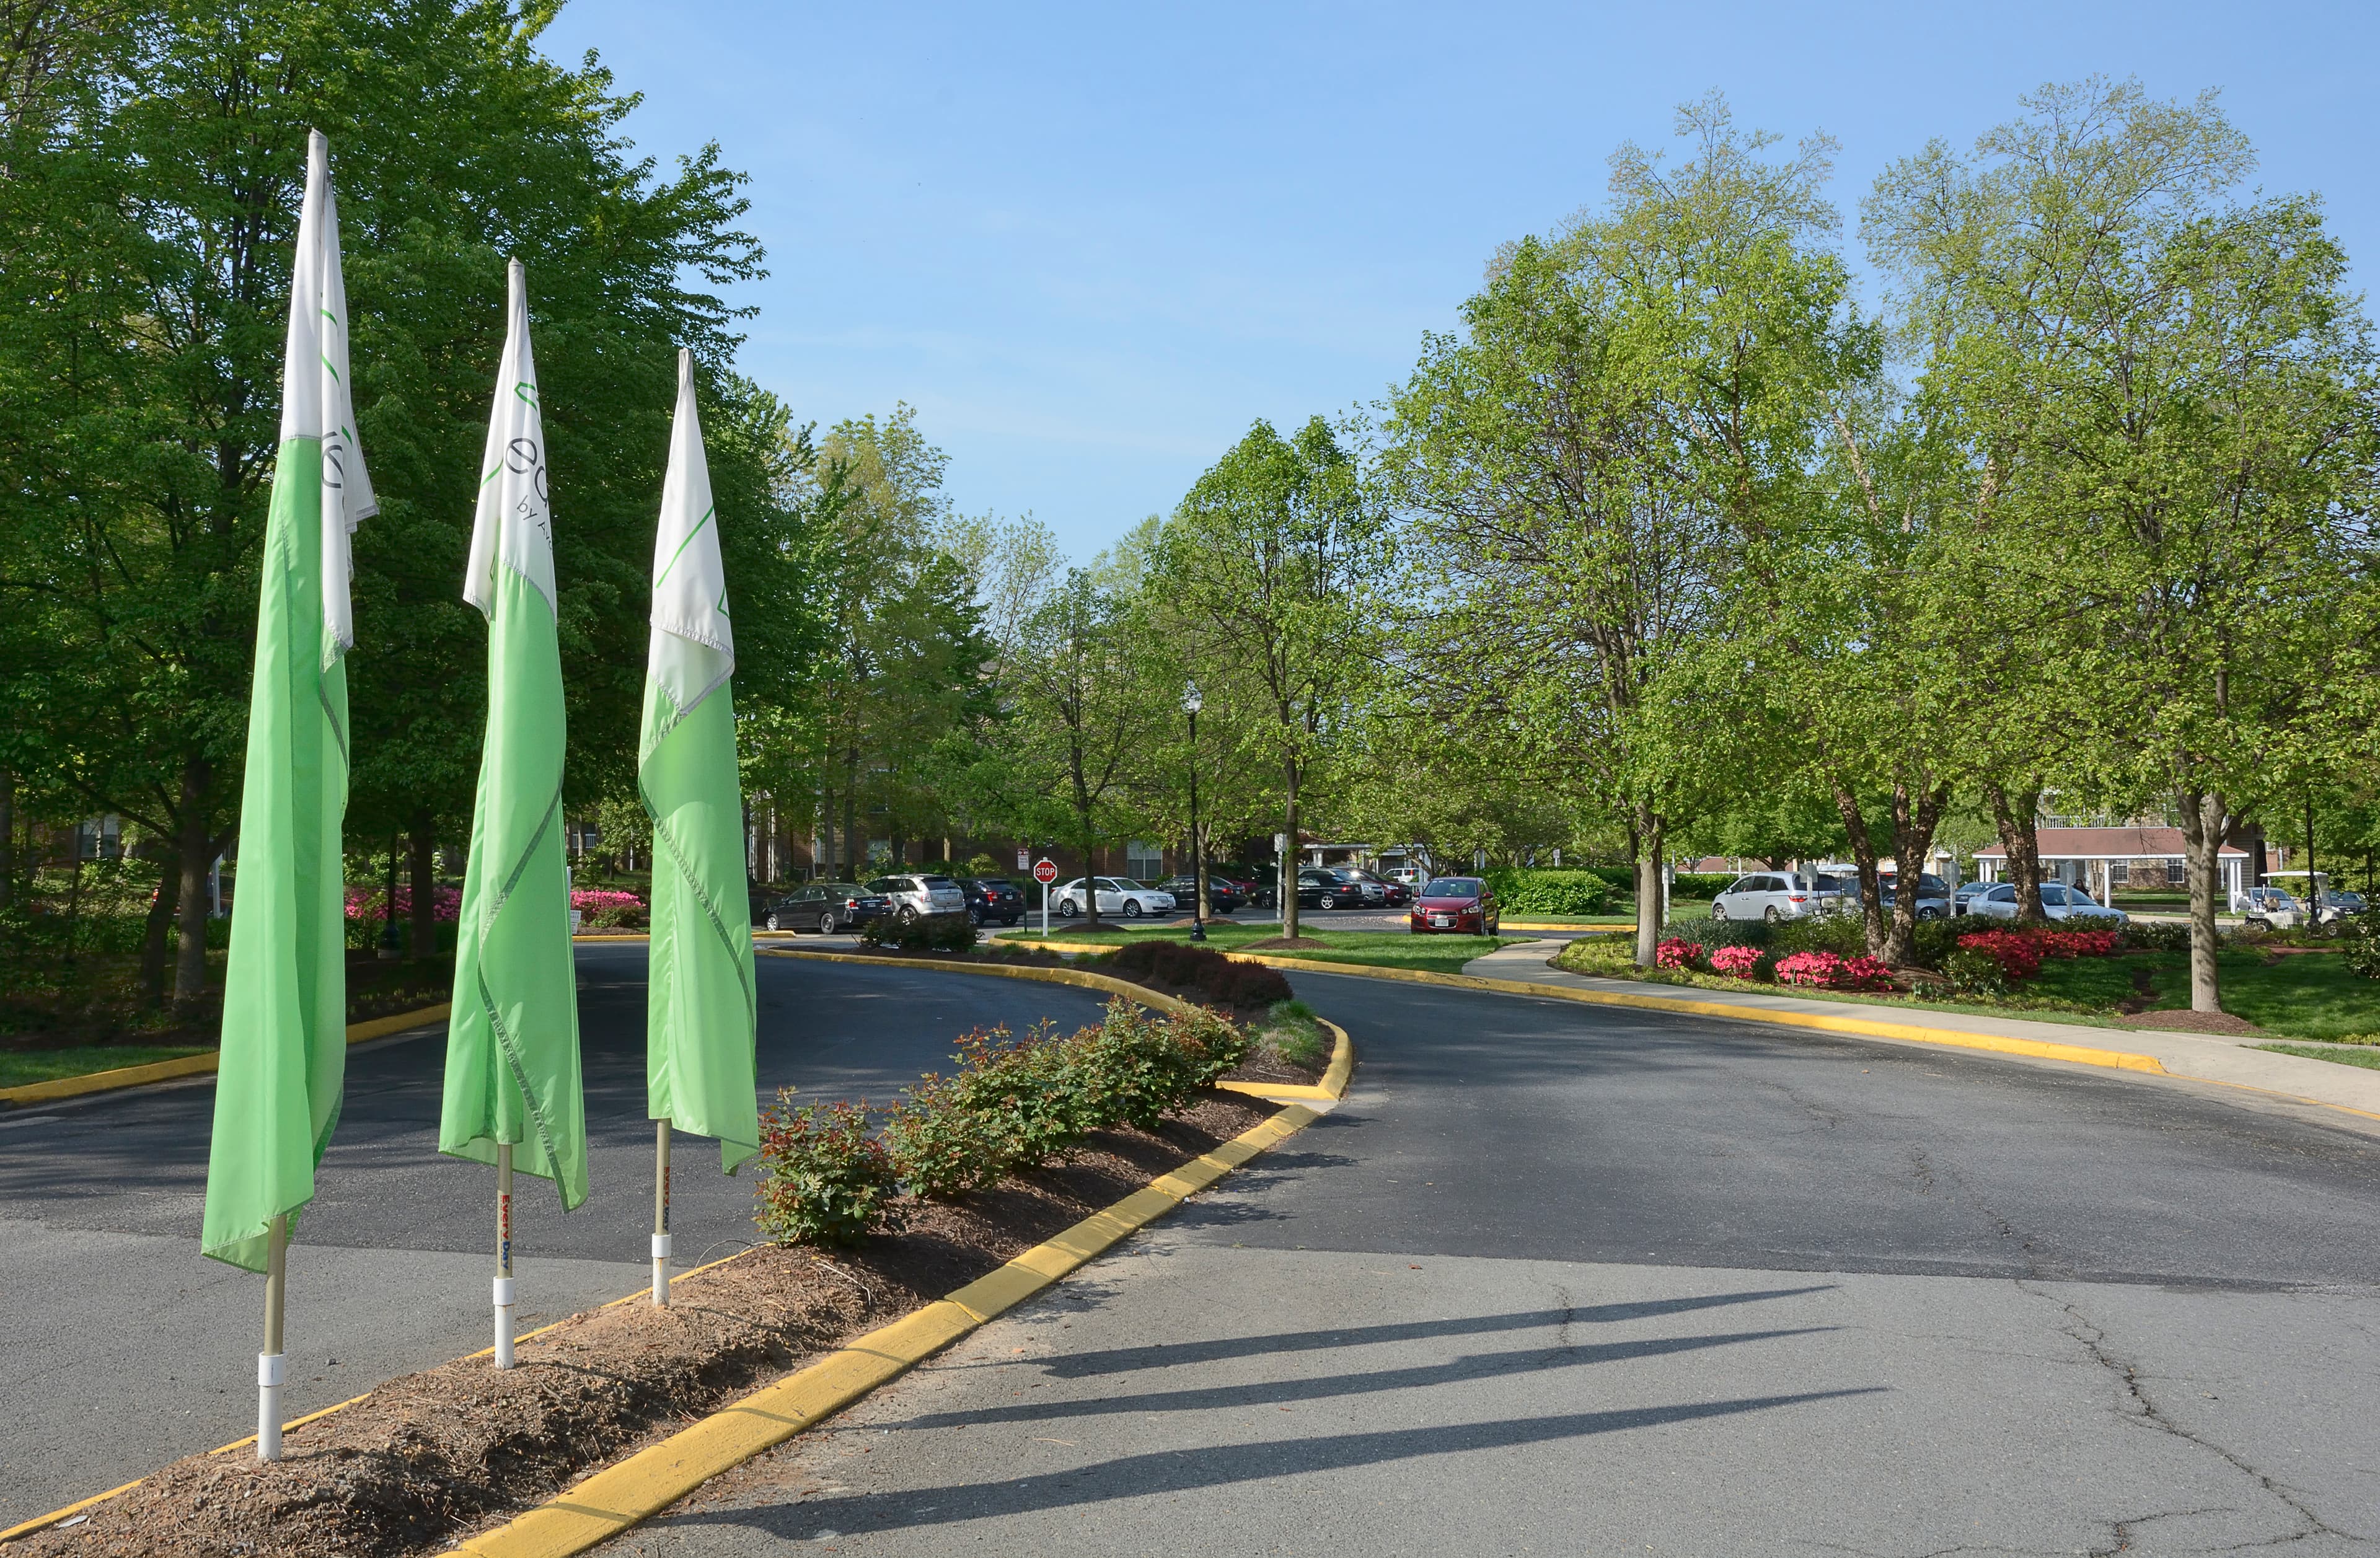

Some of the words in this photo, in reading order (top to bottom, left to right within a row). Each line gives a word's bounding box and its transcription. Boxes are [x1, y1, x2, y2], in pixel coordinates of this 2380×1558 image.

[516, 495, 538, 521] by
[1036, 868, 1055, 876] STOP
[502, 1194, 510, 1239] Every
